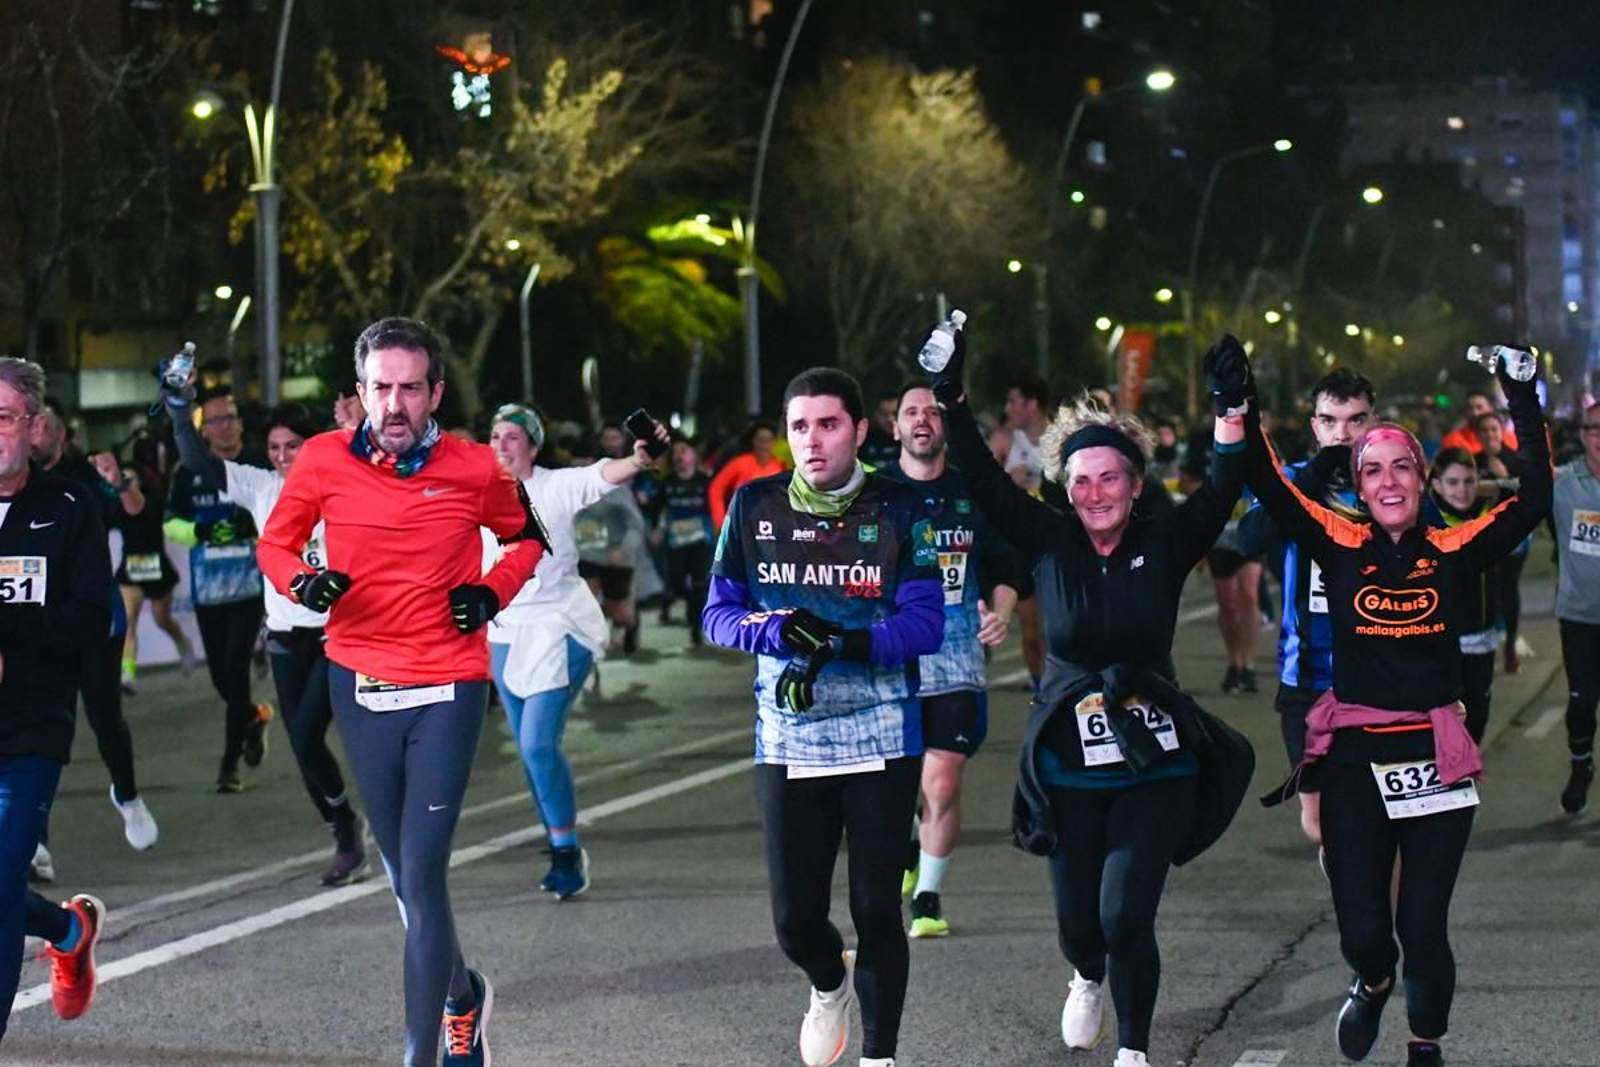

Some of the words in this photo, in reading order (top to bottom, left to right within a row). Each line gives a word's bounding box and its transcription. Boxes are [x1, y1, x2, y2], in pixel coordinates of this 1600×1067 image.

[933, 525, 974, 547] NTÓN
[757, 562, 796, 584] SAN
[802, 560, 881, 586] ANTÓN
[942, 567, 959, 585] 9
[0, 577, 33, 601] 51
[844, 580, 883, 597] 2025
[1364, 594, 1429, 612] GALBIS
[1355, 622, 1445, 638] mallasgalbis.es
[1384, 763, 1442, 793] 632
